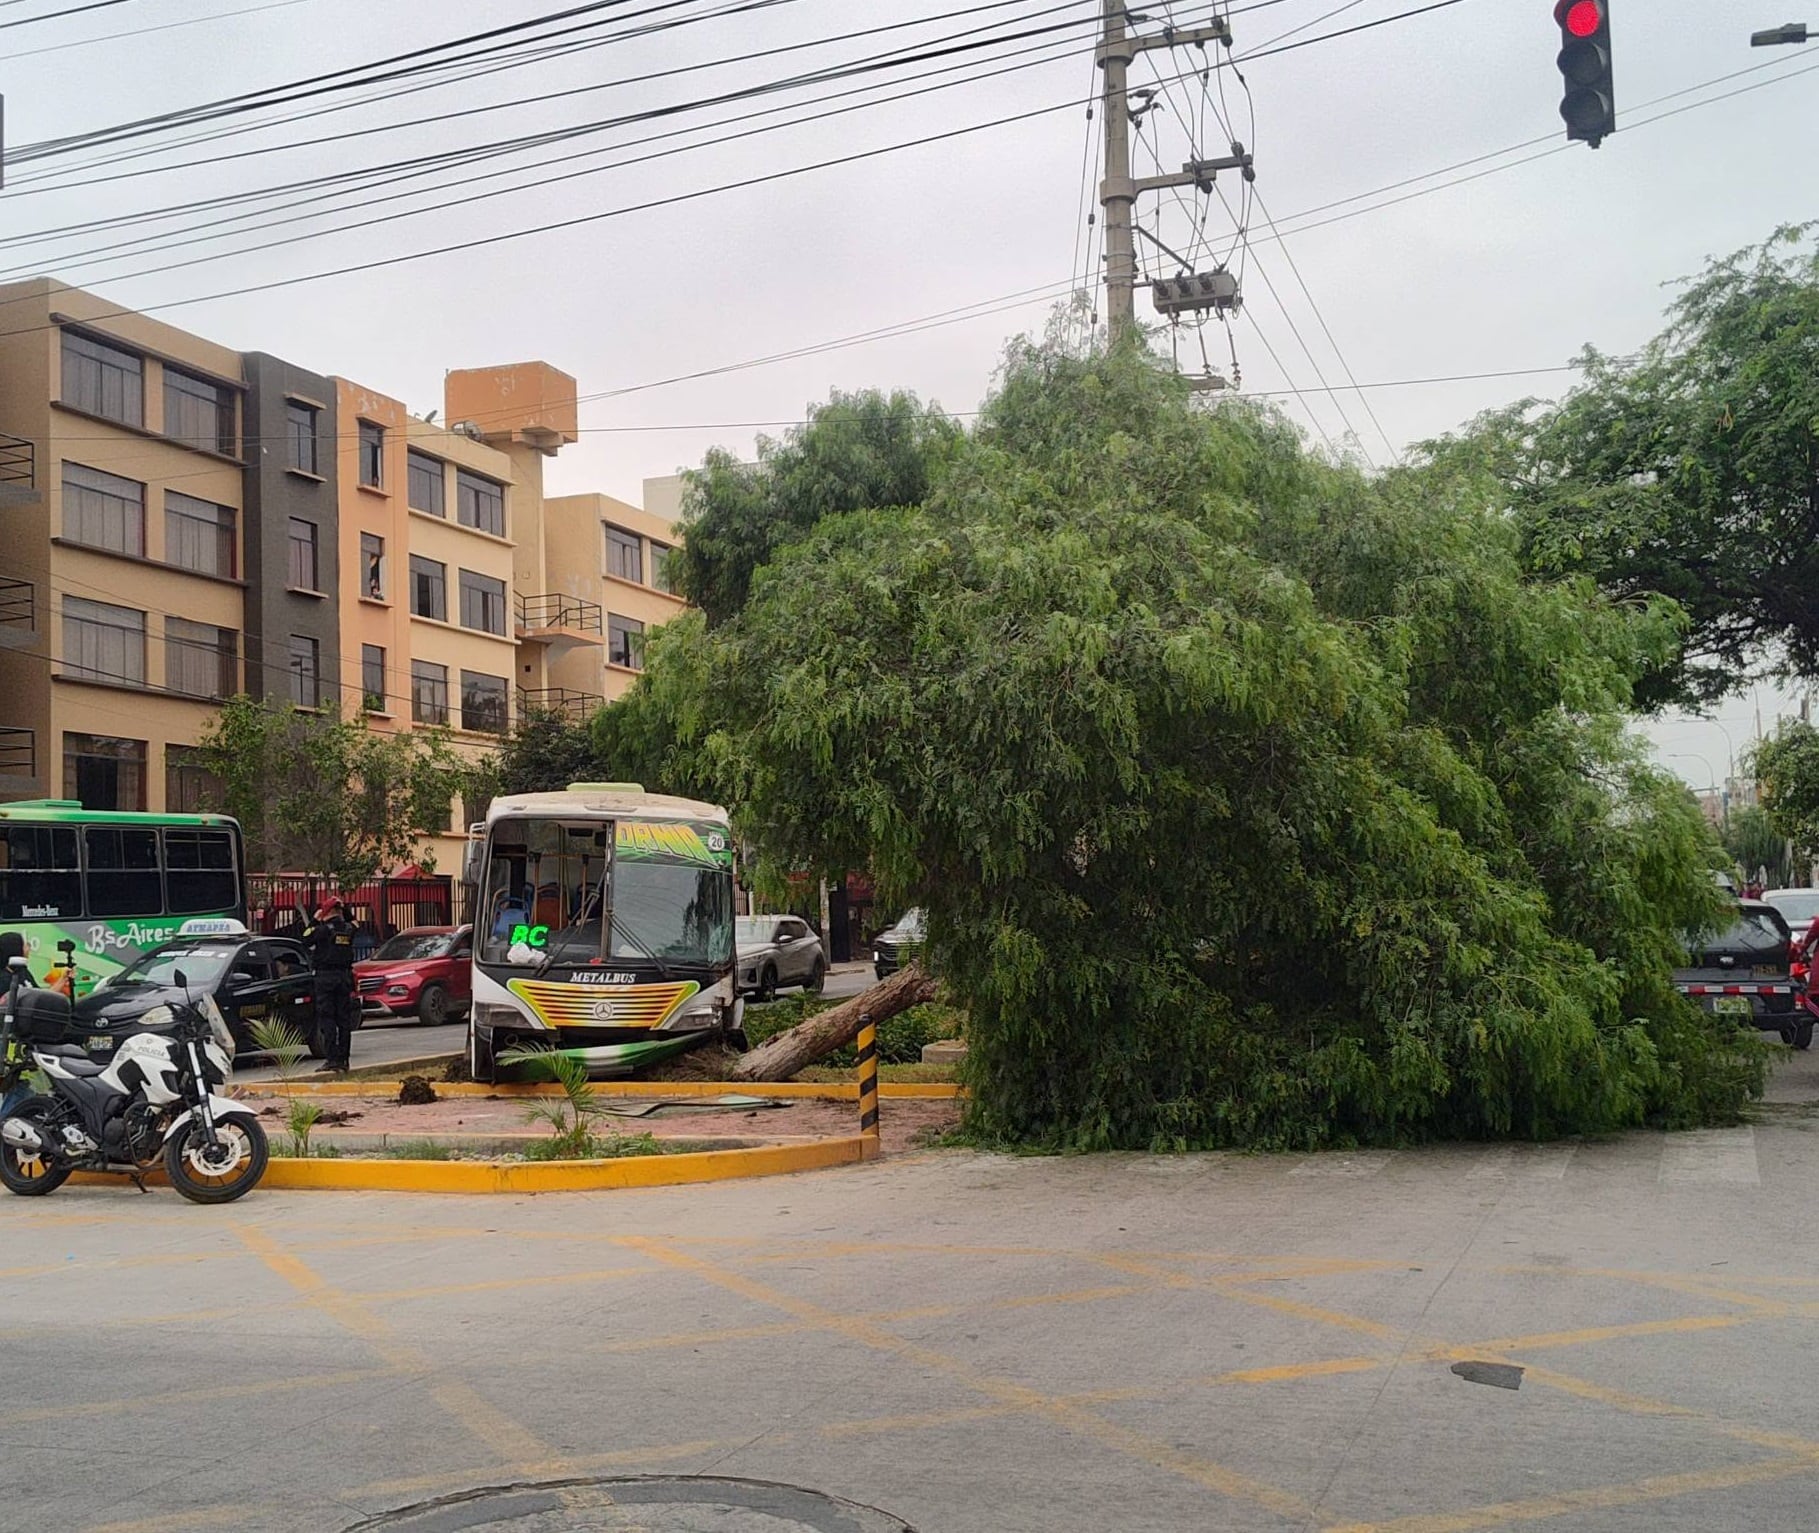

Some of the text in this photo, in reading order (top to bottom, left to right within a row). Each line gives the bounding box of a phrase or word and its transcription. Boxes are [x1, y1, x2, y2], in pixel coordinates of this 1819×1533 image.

[711, 836, 722, 848] 20
[85, 923, 174, 954] Bs Aires
[510, 925, 549, 947] BC
[569, 972, 636, 983] METALBUS
